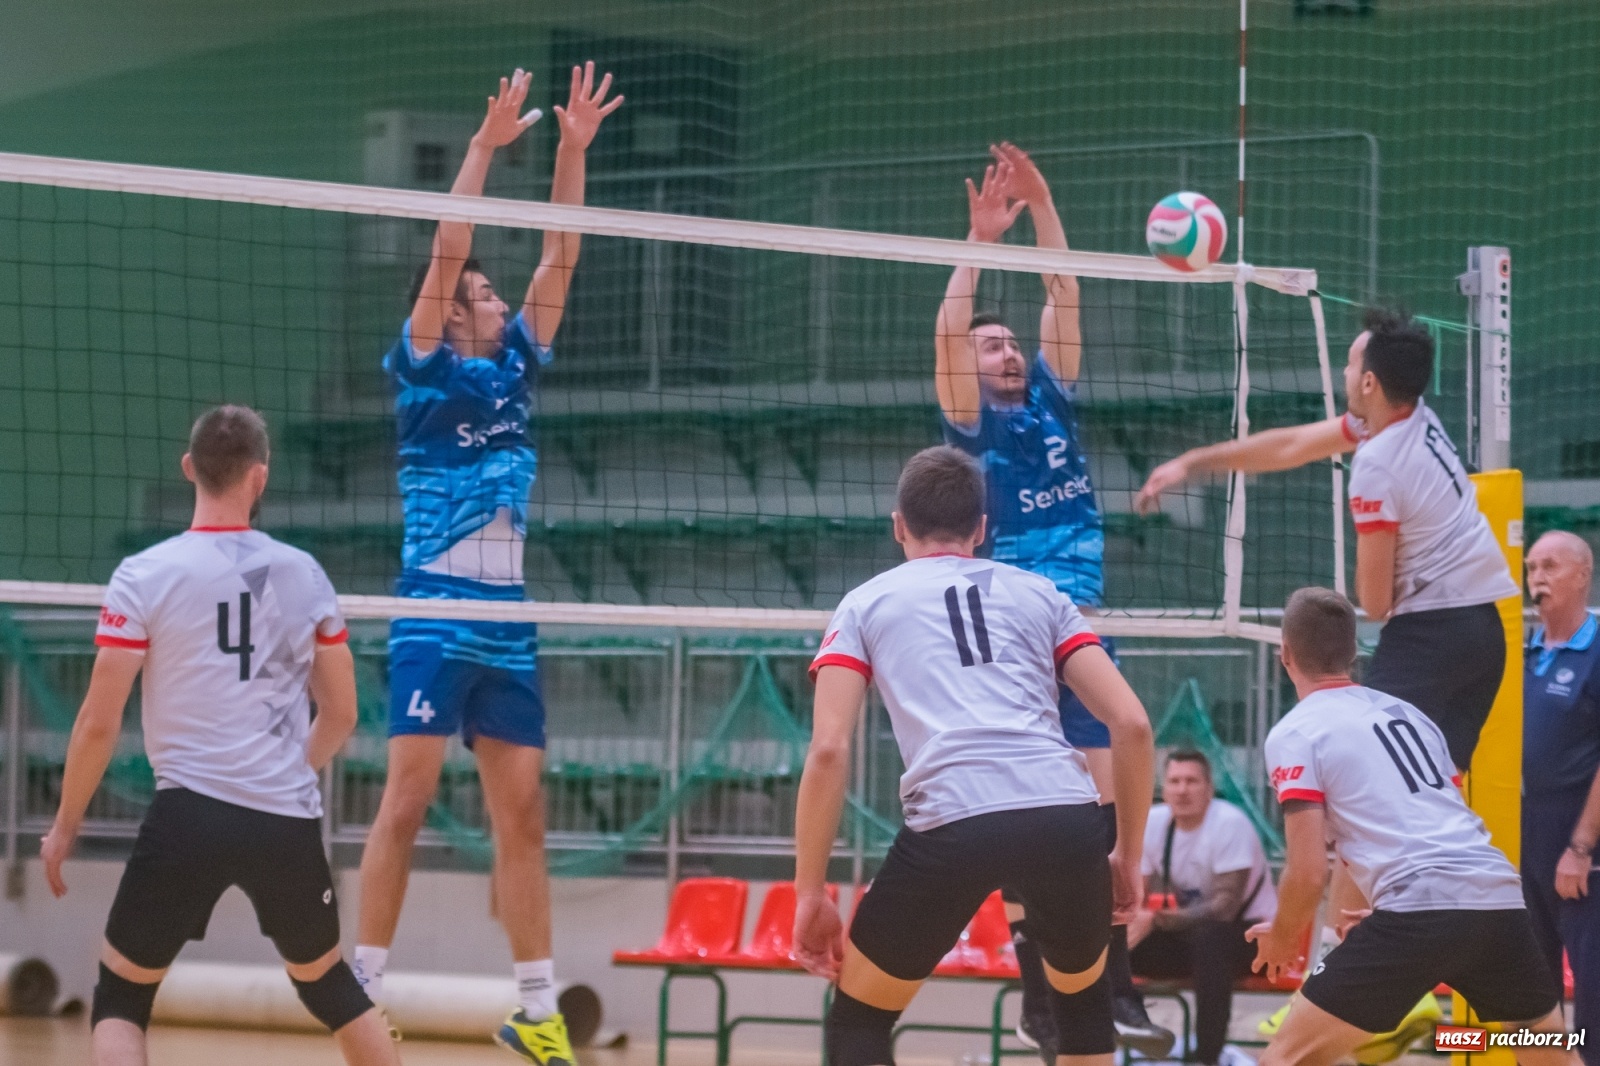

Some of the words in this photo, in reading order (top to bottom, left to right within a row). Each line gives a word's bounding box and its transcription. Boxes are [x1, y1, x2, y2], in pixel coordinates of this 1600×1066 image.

[1043, 435, 1067, 470] 2
[217, 591, 255, 681] 4
[943, 584, 994, 667] 11
[406, 689, 436, 723] 4
[1372, 719, 1445, 794] 10
